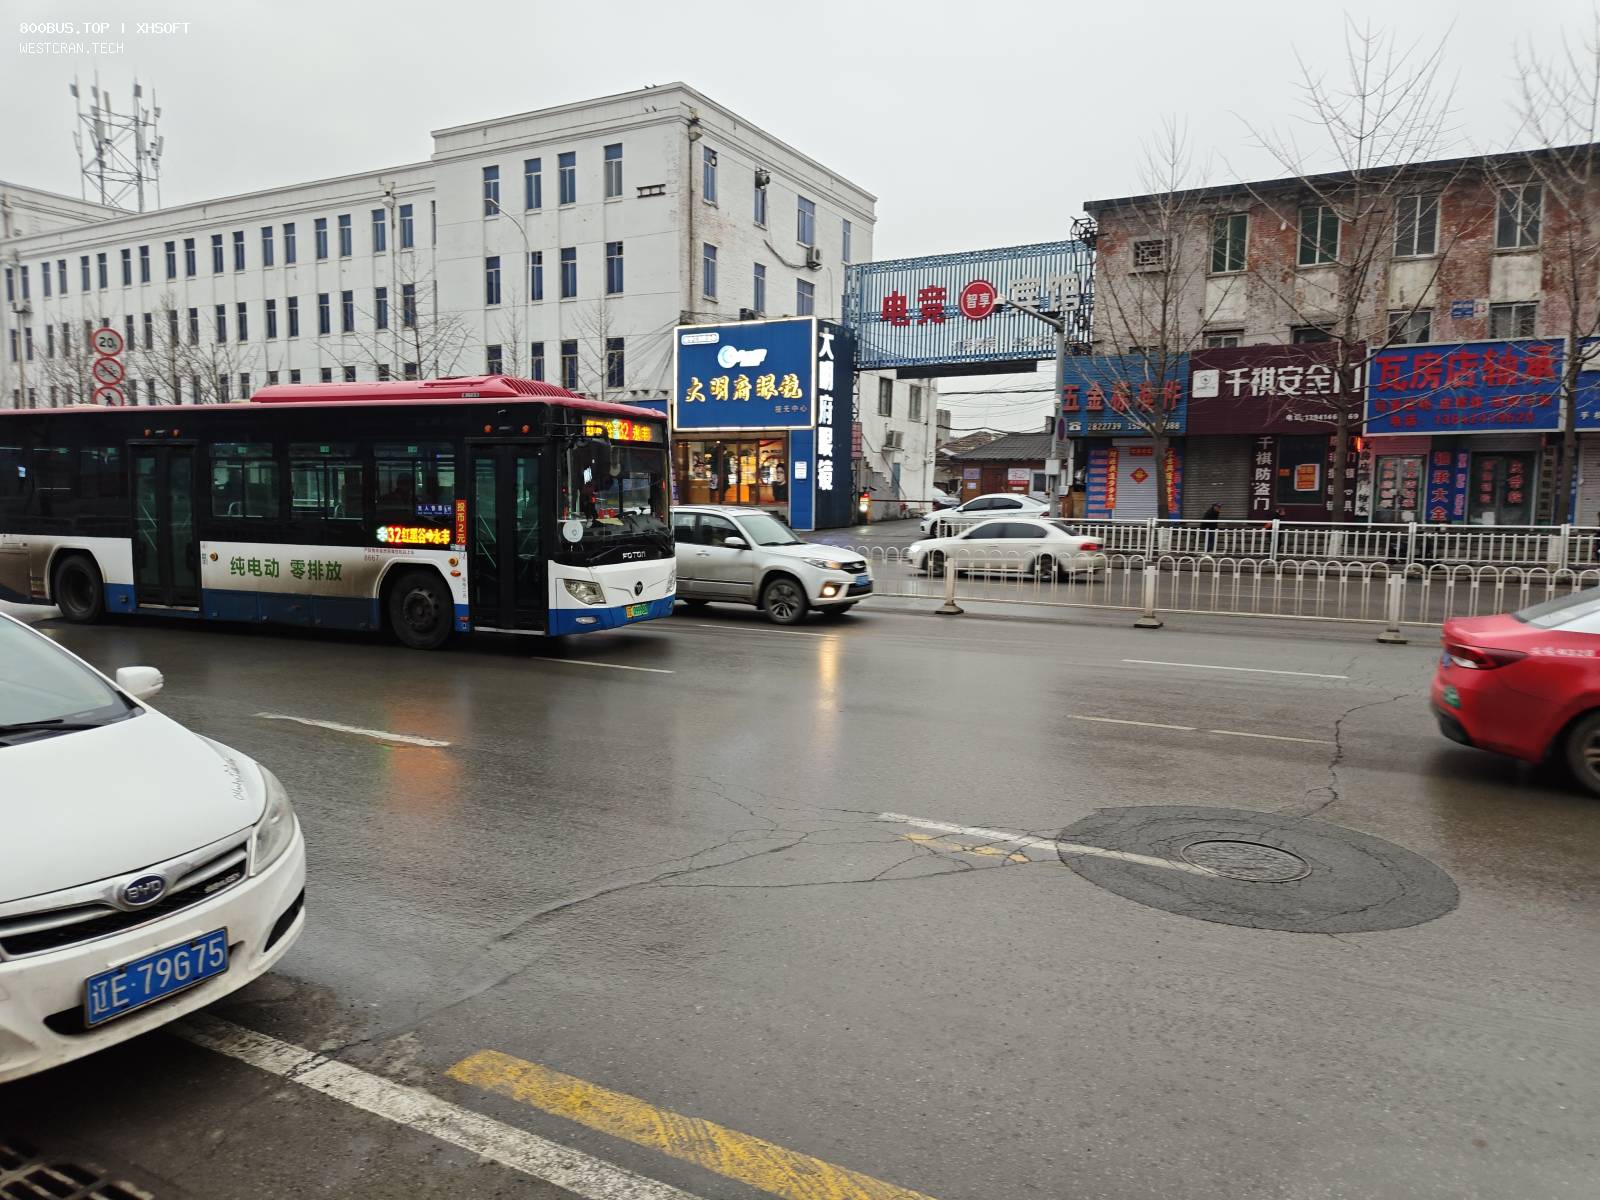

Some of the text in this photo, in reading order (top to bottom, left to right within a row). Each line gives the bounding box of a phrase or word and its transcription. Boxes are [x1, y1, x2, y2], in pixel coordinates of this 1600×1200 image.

[966, 292, 991, 310] 智享
[99, 336, 114, 348] 20
[1375, 345, 1556, 392] 瓦房店轴承
[684, 373, 804, 404] 大明府眼镜
[388, 526, 402, 544] 32
[622, 551, 646, 560] FOTON
[230, 556, 342, 581] 纯电动 零排放
[127, 879, 162, 900] BYD
